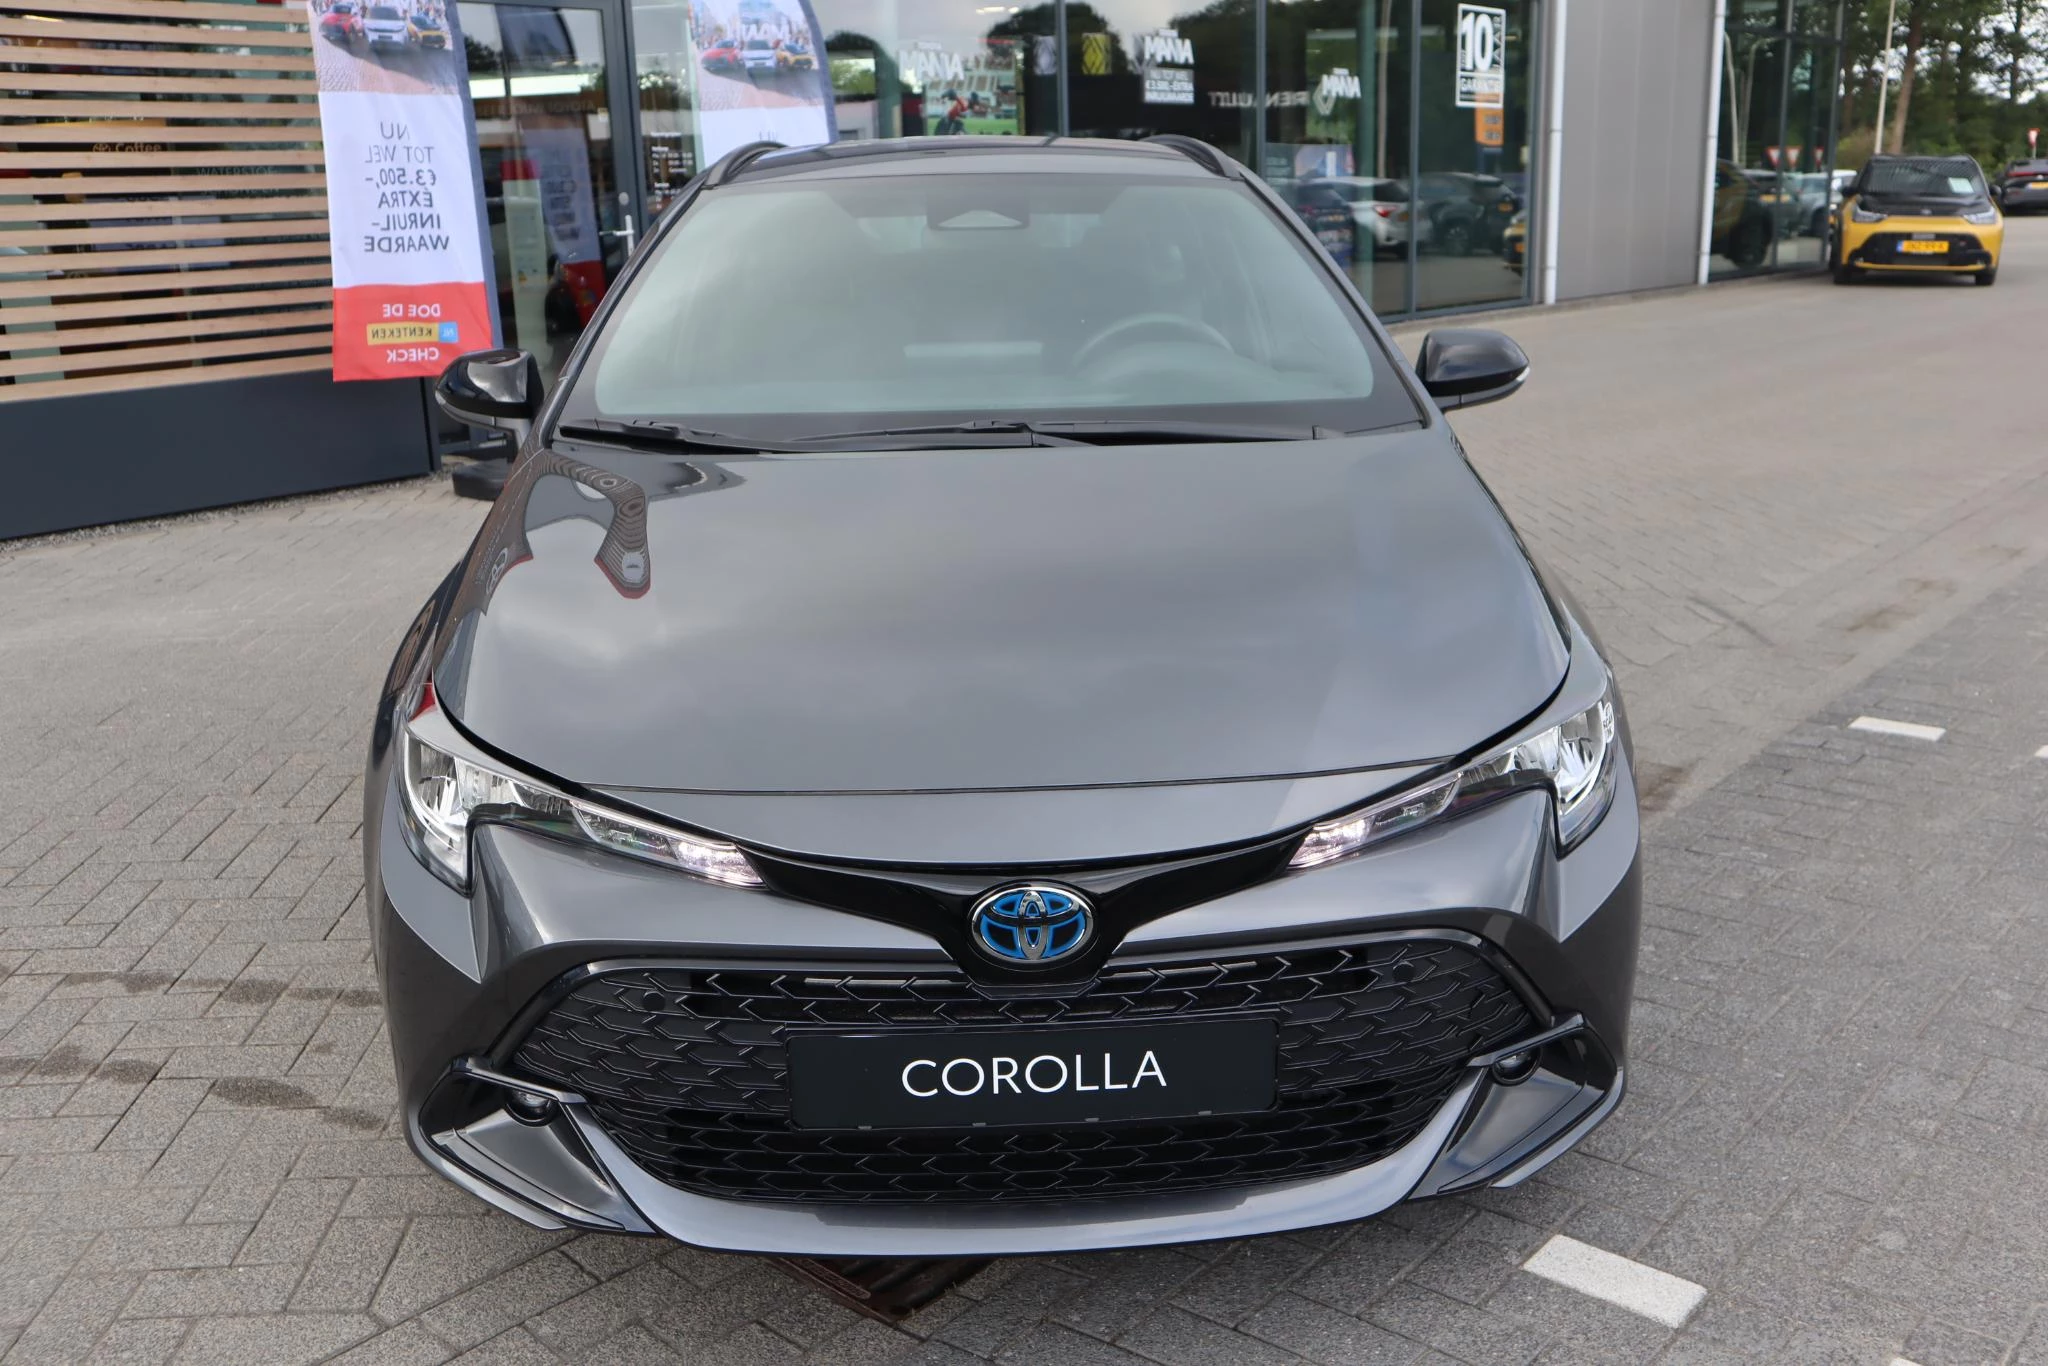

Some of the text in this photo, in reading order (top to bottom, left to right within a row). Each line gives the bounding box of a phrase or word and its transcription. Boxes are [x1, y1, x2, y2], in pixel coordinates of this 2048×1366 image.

[1144, 35, 1195, 65] MANIA
[1461, 12, 1494, 72] 10
[899, 49, 964, 81] MANIA
[901, 1050, 1168, 1098] COROLLA
